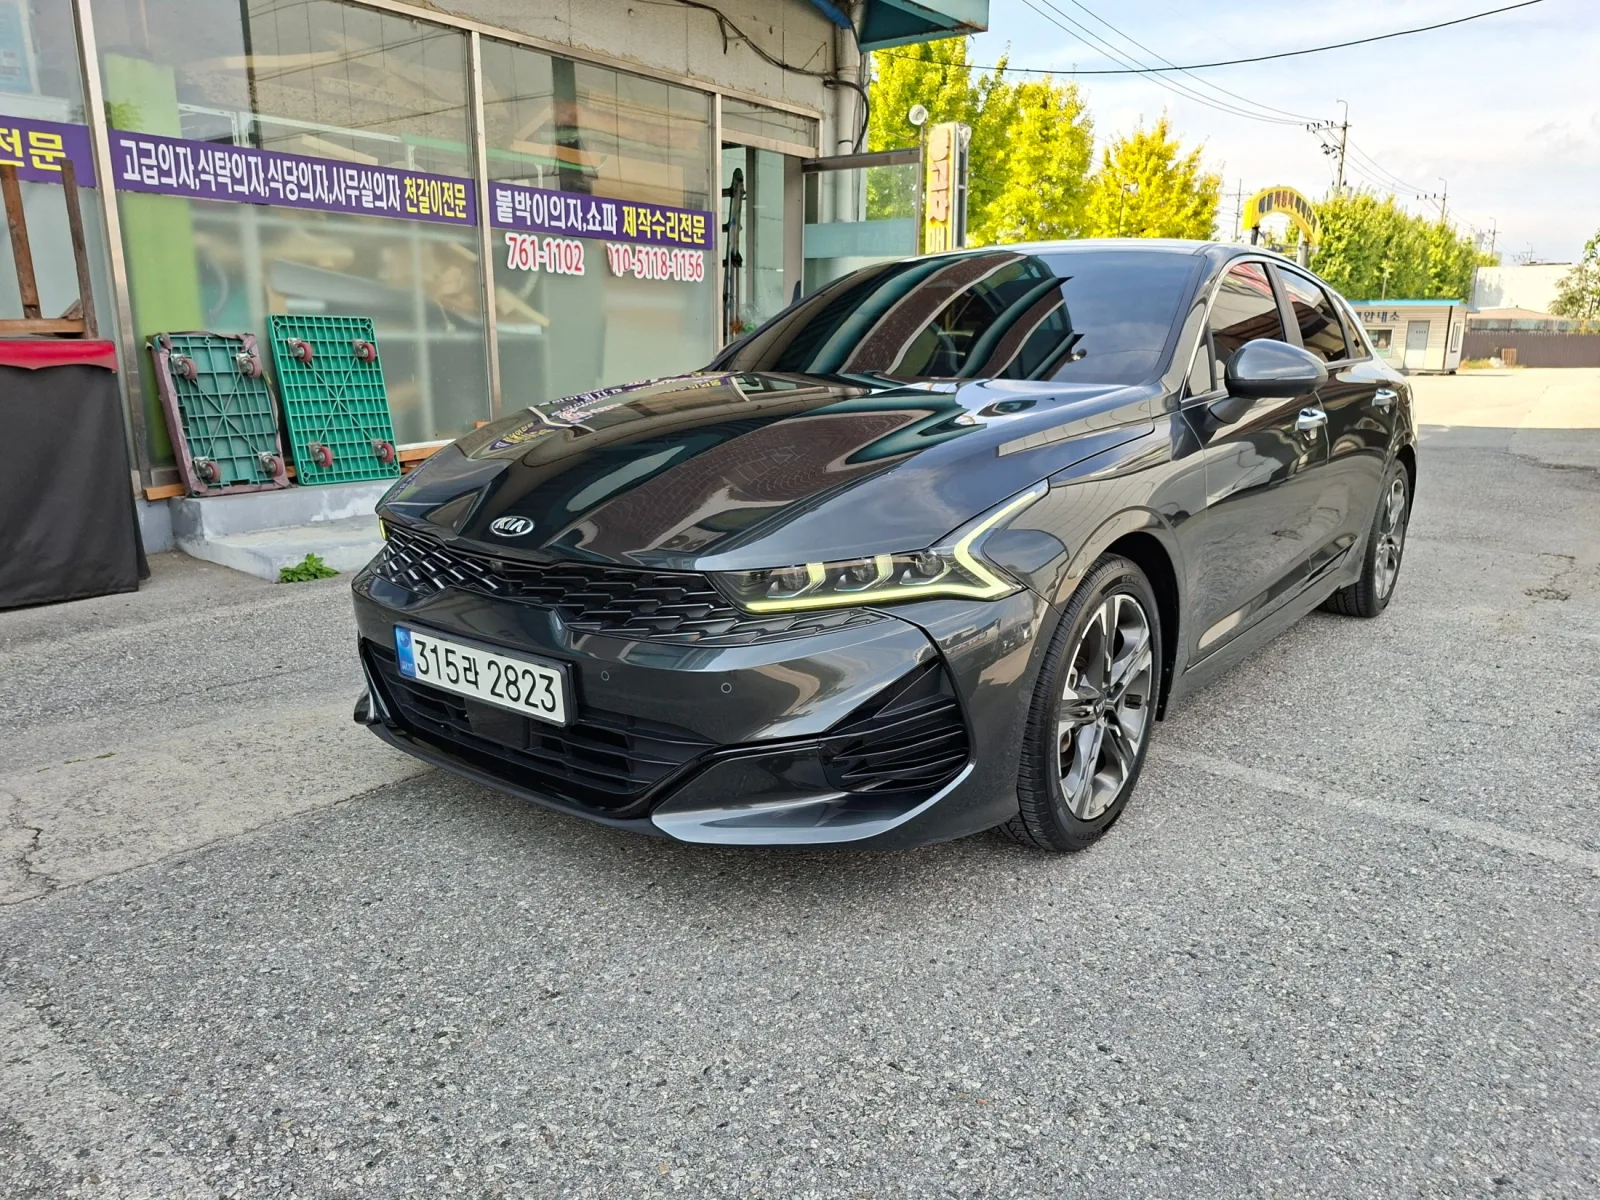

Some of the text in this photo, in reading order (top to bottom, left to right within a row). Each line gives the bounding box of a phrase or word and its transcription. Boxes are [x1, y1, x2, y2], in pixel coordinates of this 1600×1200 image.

[0, 127, 66, 171] 전문
[119, 139, 467, 219] 고급의자,식탁의자,식당의자,사무실의자 천갈이전문
[495, 188, 706, 244] 붙박이의자,쇼파 제작수리전문
[507, 236, 583, 273] 761-1102
[495, 516, 524, 533] KIA
[414, 639, 557, 713] 315라 2823
